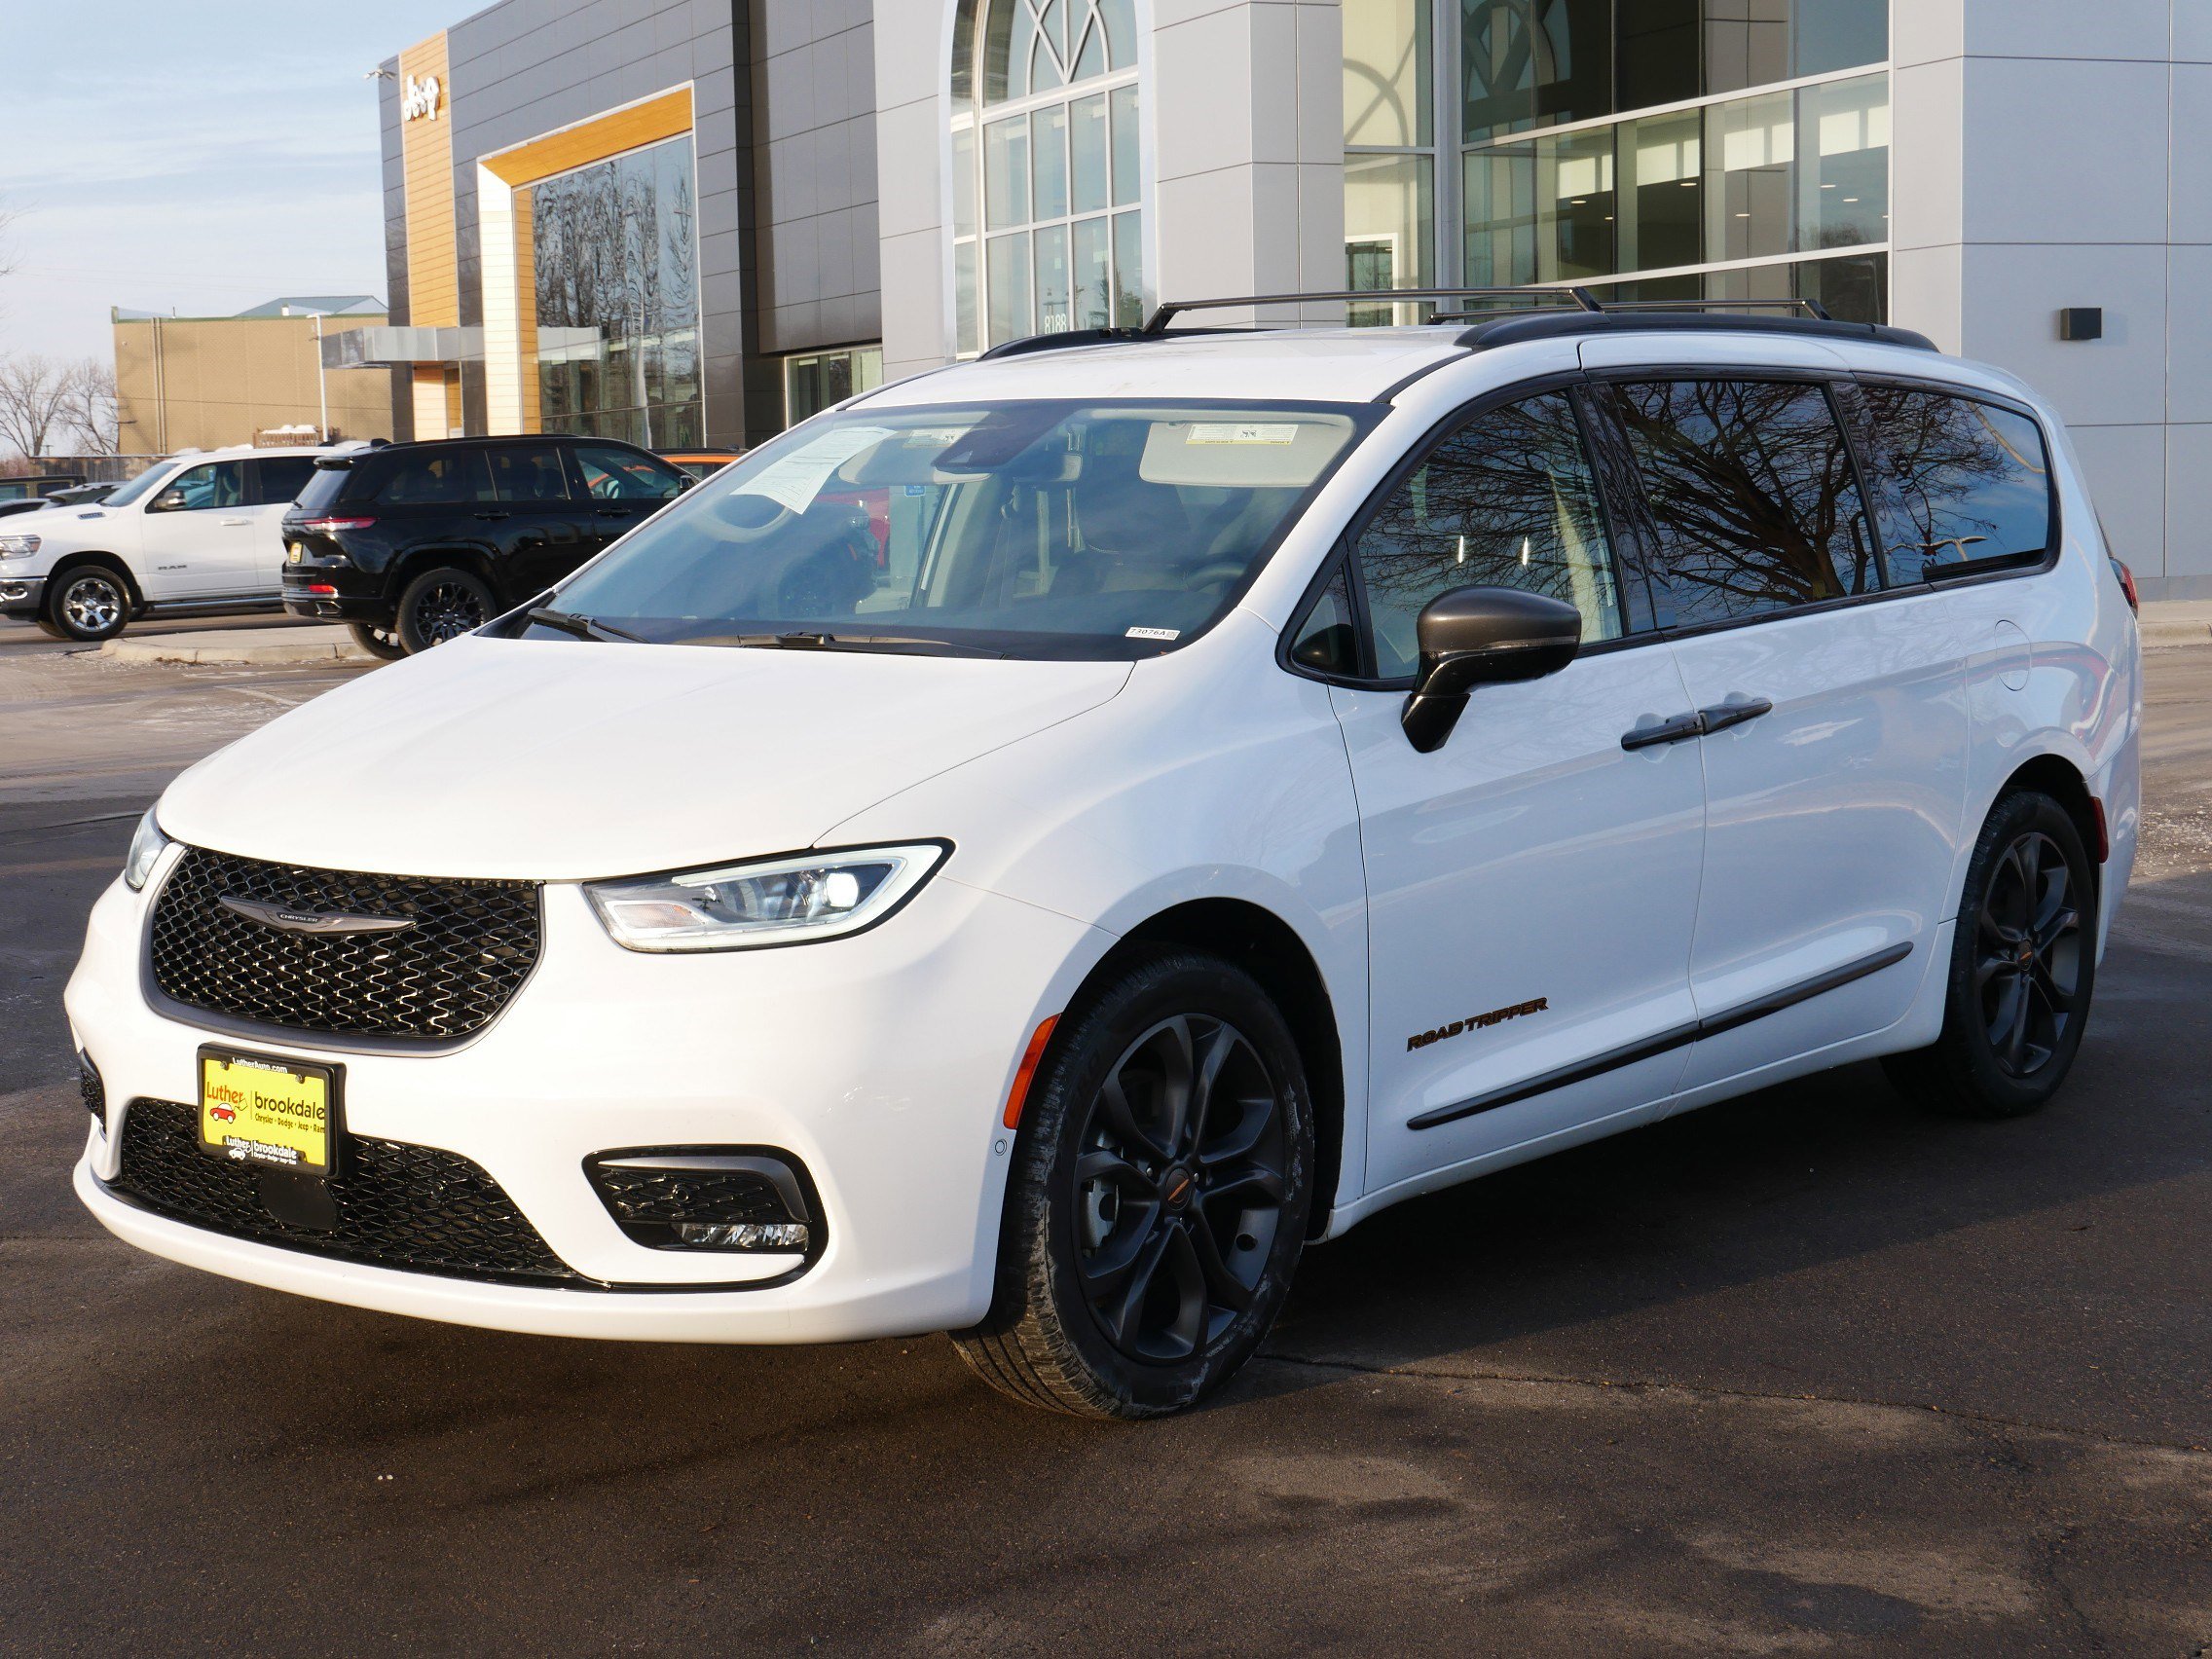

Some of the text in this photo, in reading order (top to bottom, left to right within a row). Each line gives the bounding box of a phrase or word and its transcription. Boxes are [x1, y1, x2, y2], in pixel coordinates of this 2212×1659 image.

[1044, 313, 1067, 334] 8188
[1130, 628, 1166, 637] 73076A
[279, 913, 318, 922] CHRYSLER
[1407, 997, 1549, 1051] ROAD TRIPPER
[232, 1056, 288, 1074] LutherAuto.com
[206, 1082, 325, 1120] Luther brookdale
[255, 1113, 274, 1124] Chrysler
[277, 1118, 294, 1129] Dodge
[298, 1121, 310, 1132] Jeep
[226, 1135, 297, 1160] Luther brookdale
